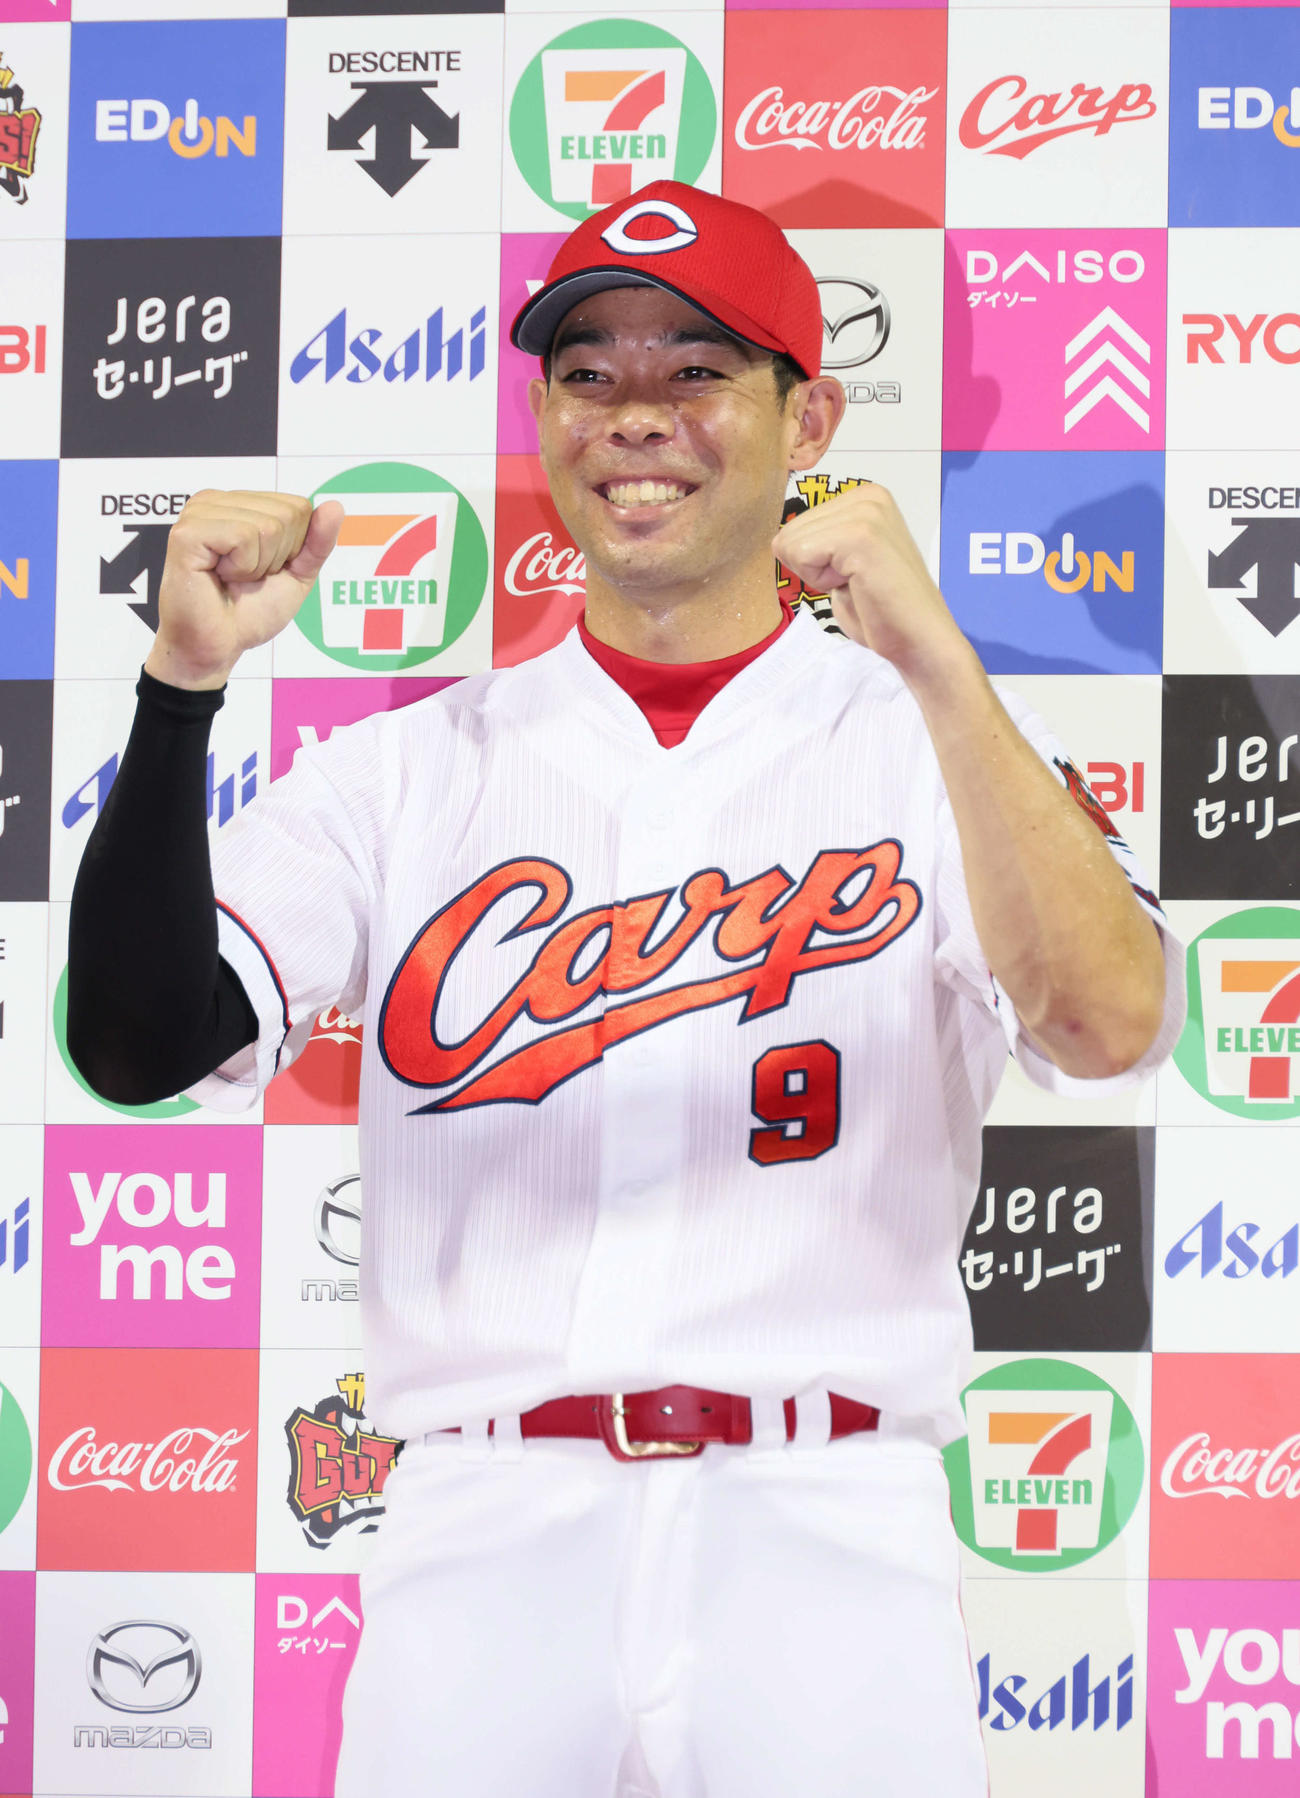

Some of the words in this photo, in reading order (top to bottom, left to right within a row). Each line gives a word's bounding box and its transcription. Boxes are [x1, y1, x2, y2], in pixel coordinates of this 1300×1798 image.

[328, 51, 461, 73] DESCENTE
[95, 99, 256, 158] EDION
[735, 85, 940, 151] Coca-Cola
[959, 75, 1157, 160] Carp
[966, 250, 1145, 284] DAISO
[966, 291, 1037, 309] ダイソー
[290, 306, 487, 384] Asahi
[101, 494, 191, 516] DESCE
[1208, 486, 1300, 509] DESCE
[968, 533, 1135, 594] EDION
[378, 839, 922, 1115] Carp
[748, 1039, 842, 1167] 9
[69, 1172, 226, 1246] you
[100, 1245, 236, 1300] me
[48, 1426, 250, 1493] Coca-Cola
[277, 1637, 347, 1655] ダイソー
